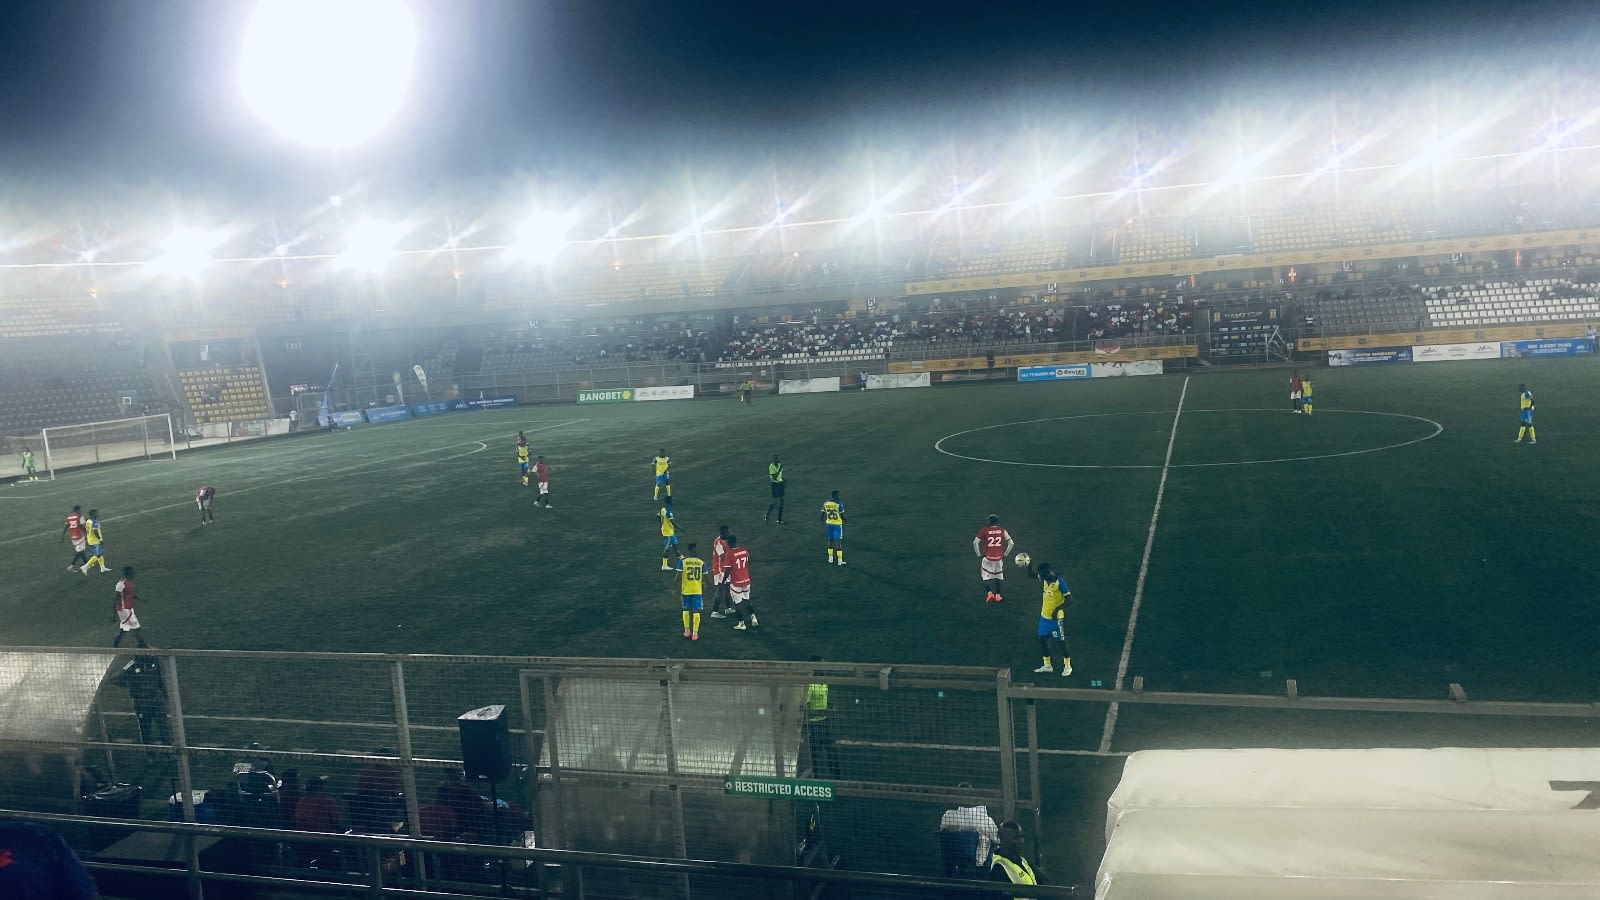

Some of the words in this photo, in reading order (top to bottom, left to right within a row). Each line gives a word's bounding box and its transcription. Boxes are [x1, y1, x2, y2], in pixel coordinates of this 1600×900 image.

[579, 391, 622, 402] BANGBET
[988, 536, 1002, 547] 22
[735, 556, 747, 569] 17
[686, 566, 701, 581] 20
[735, 781, 792, 795] RESTRICTED
[794, 785, 832, 798] ACCESS
